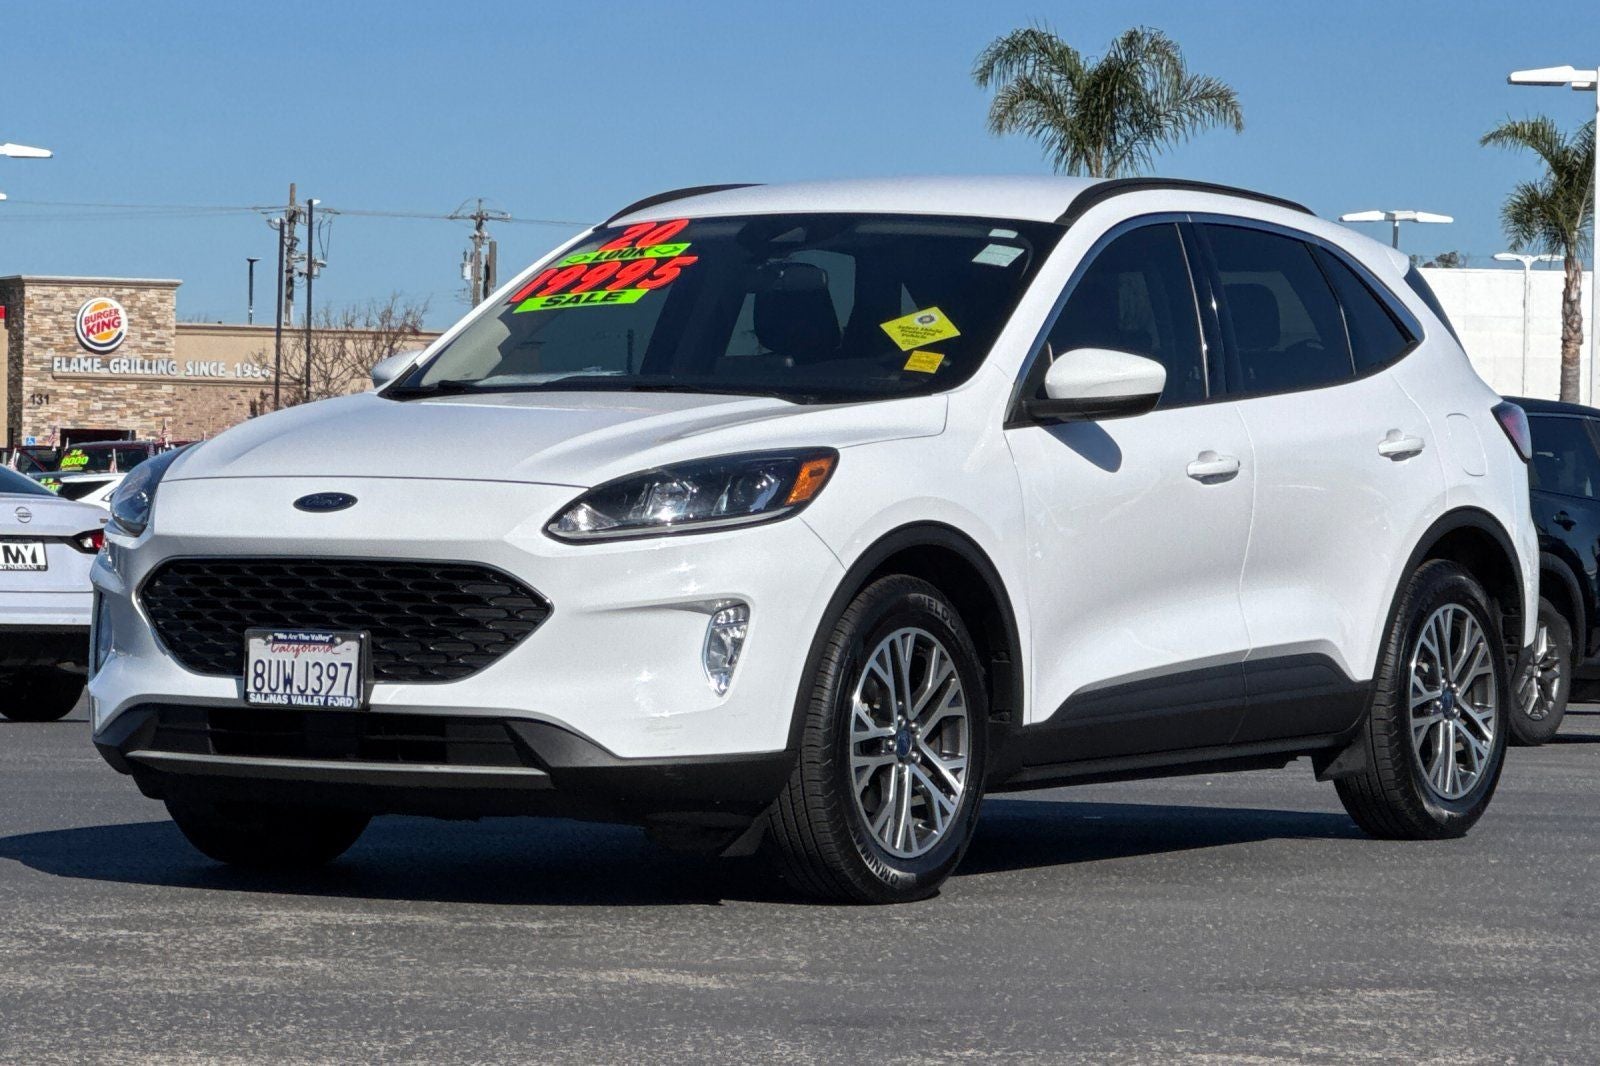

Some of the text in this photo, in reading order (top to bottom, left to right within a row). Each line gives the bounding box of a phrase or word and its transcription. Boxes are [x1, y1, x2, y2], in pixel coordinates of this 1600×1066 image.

[598, 218, 690, 251] 20
[591, 246, 648, 262] LOOK
[508, 256, 699, 305] 19995
[540, 290, 627, 308] SALE
[84, 308, 120, 326] BURGER
[85, 316, 122, 338] KING
[109, 358, 177, 375] GRILLING
[185, 361, 225, 377] SINCE
[234, 363, 271, 379] 1954
[30, 393, 50, 405] 131
[299, 633, 310, 641] The
[270, 642, 341, 659] California
[253, 659, 353, 697] 8UWJ397
[249, 693, 353, 708] SALINAS VALLEY FORD
